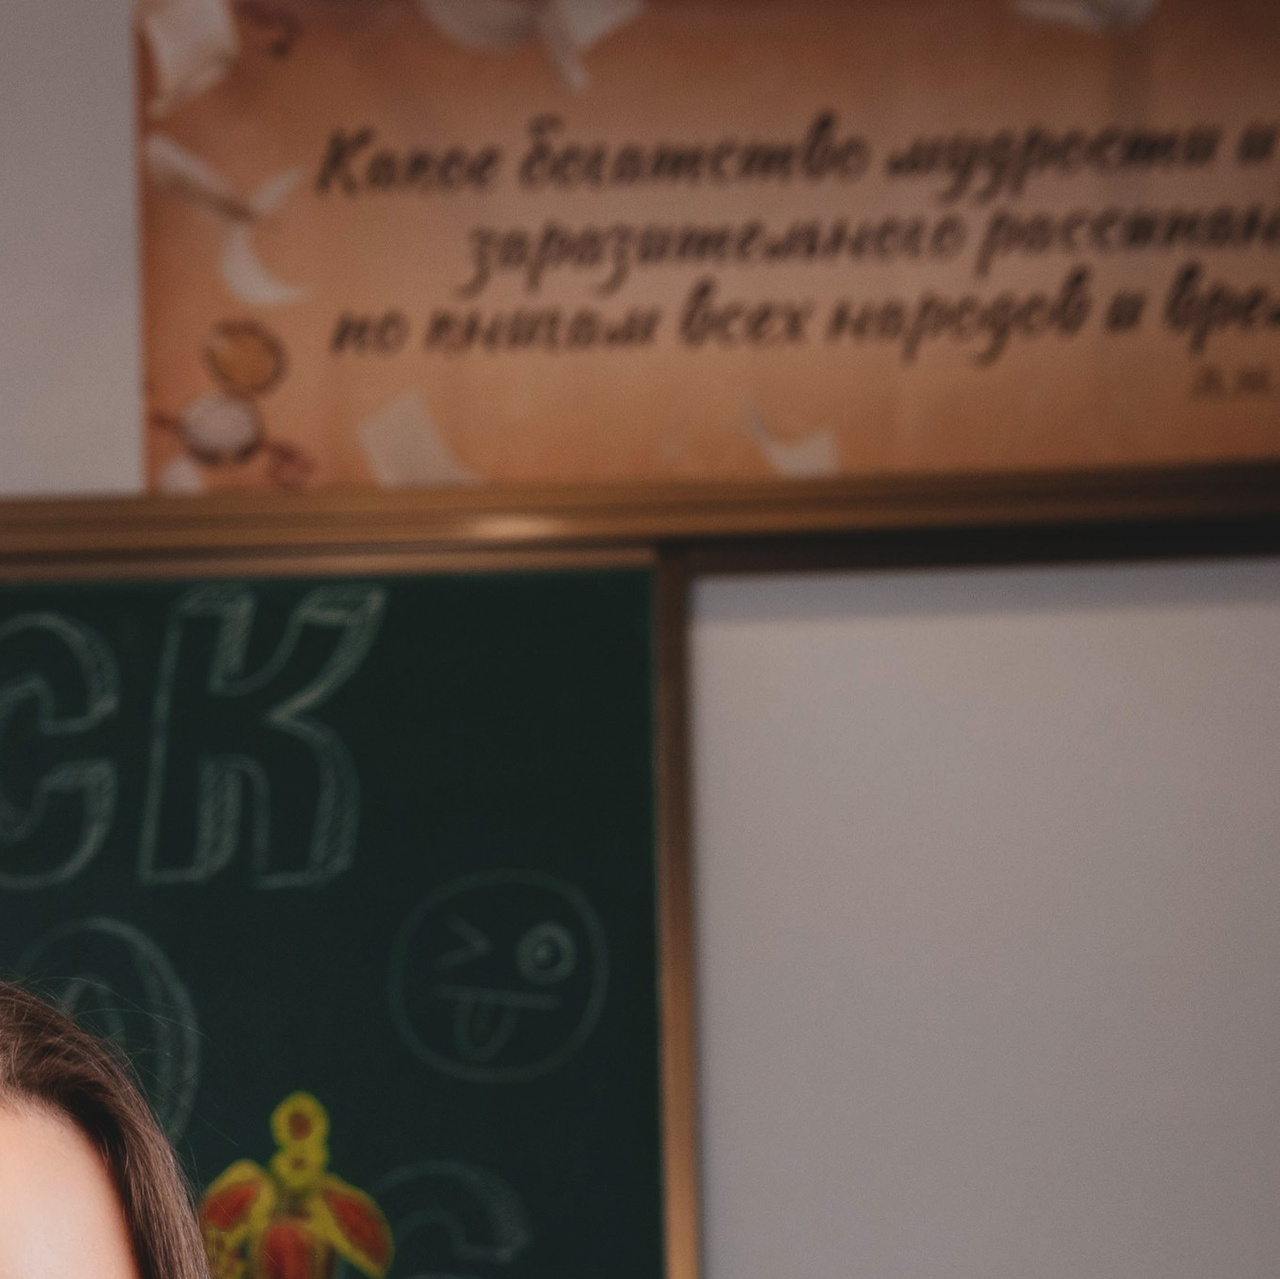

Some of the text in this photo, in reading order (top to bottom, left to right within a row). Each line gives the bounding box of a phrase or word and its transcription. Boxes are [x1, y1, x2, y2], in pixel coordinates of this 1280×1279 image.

[316, 125, 503, 196] Какое
[519, 108, 870, 185] богатство
[886, 123, 1222, 205] мудрости
[457, 212, 967, 297] заразительного
[329, 308, 410, 358] по
[423, 307, 664, 358] книгам
[678, 276, 814, 349] всех
[825, 262, 1094, 368] народов
[1106, 291, 1150, 337] и
